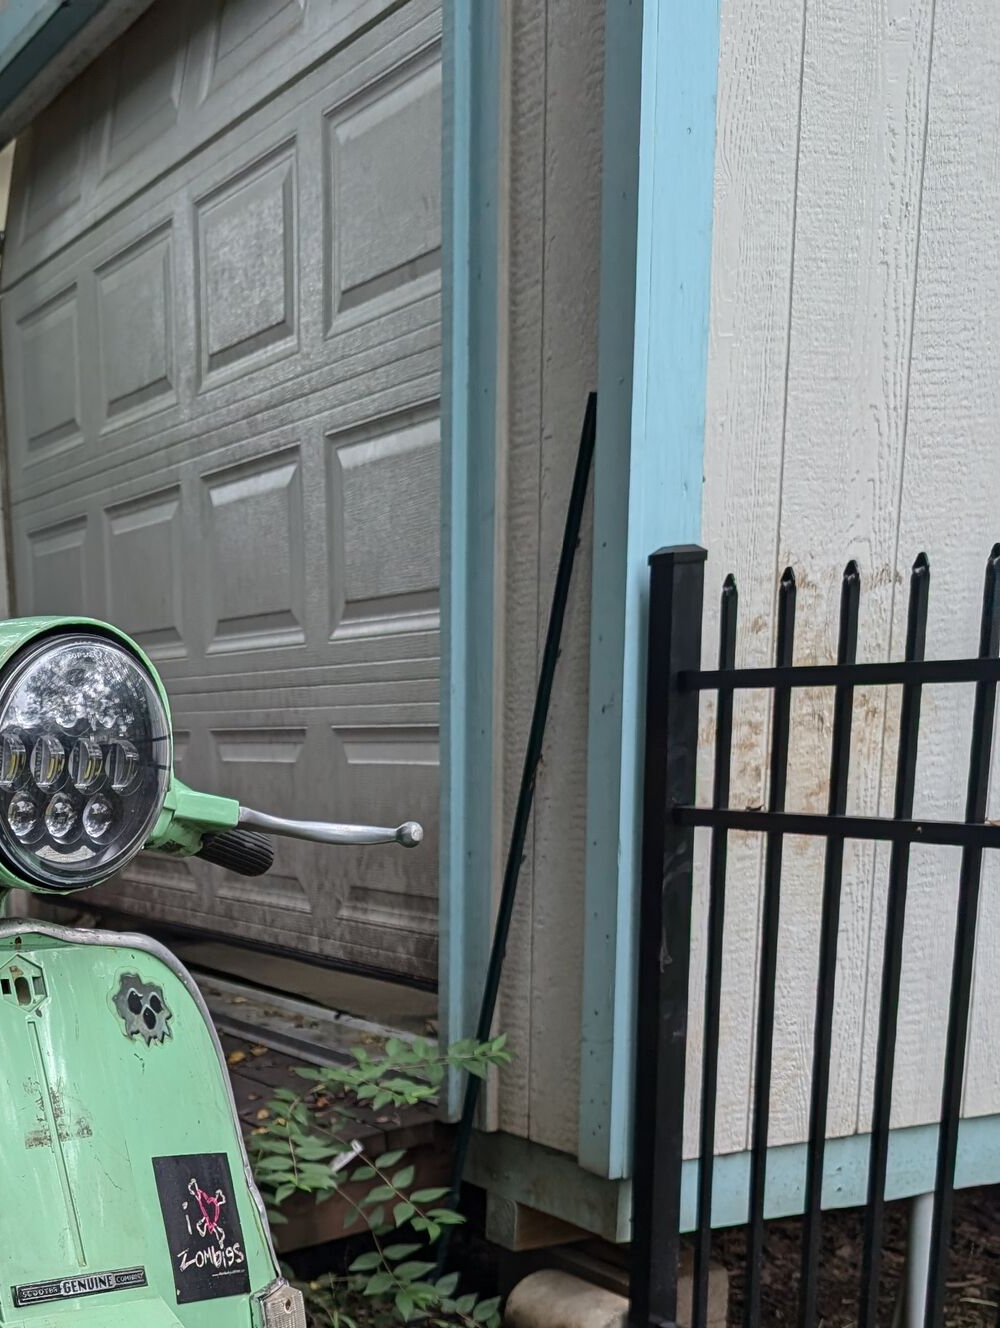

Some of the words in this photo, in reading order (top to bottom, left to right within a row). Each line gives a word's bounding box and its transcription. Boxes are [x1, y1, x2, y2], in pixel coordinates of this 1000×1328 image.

[22, 1286, 59, 1298] SCOOTER
[63, 1274, 113, 1294] GENUINE
[115, 1272, 144, 1284] COMPANY
